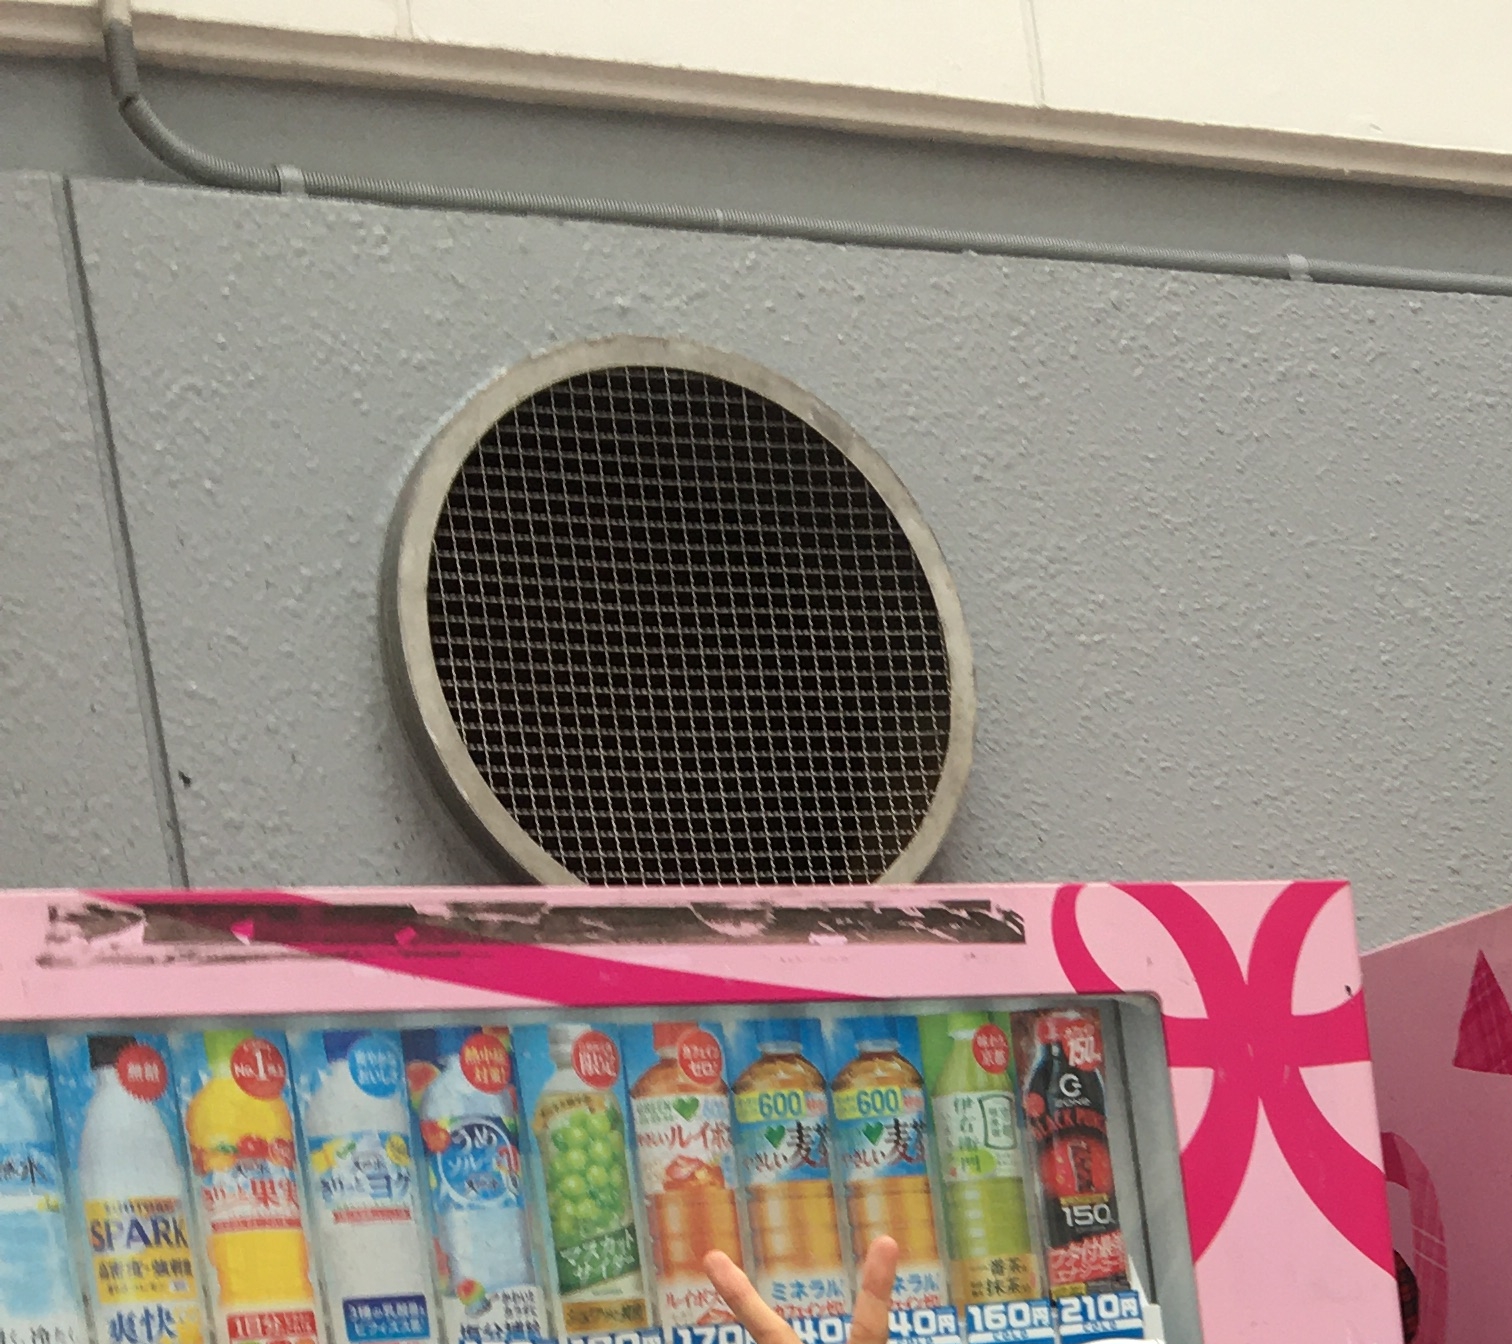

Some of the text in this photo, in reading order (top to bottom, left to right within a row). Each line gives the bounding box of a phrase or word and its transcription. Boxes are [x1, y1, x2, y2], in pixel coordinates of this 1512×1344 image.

[759, 1090, 800, 1117] 600
[856, 1088, 898, 1115] 600
[90, 1211, 190, 1252] SPARK
[888, 1308, 958, 1336] 40円
